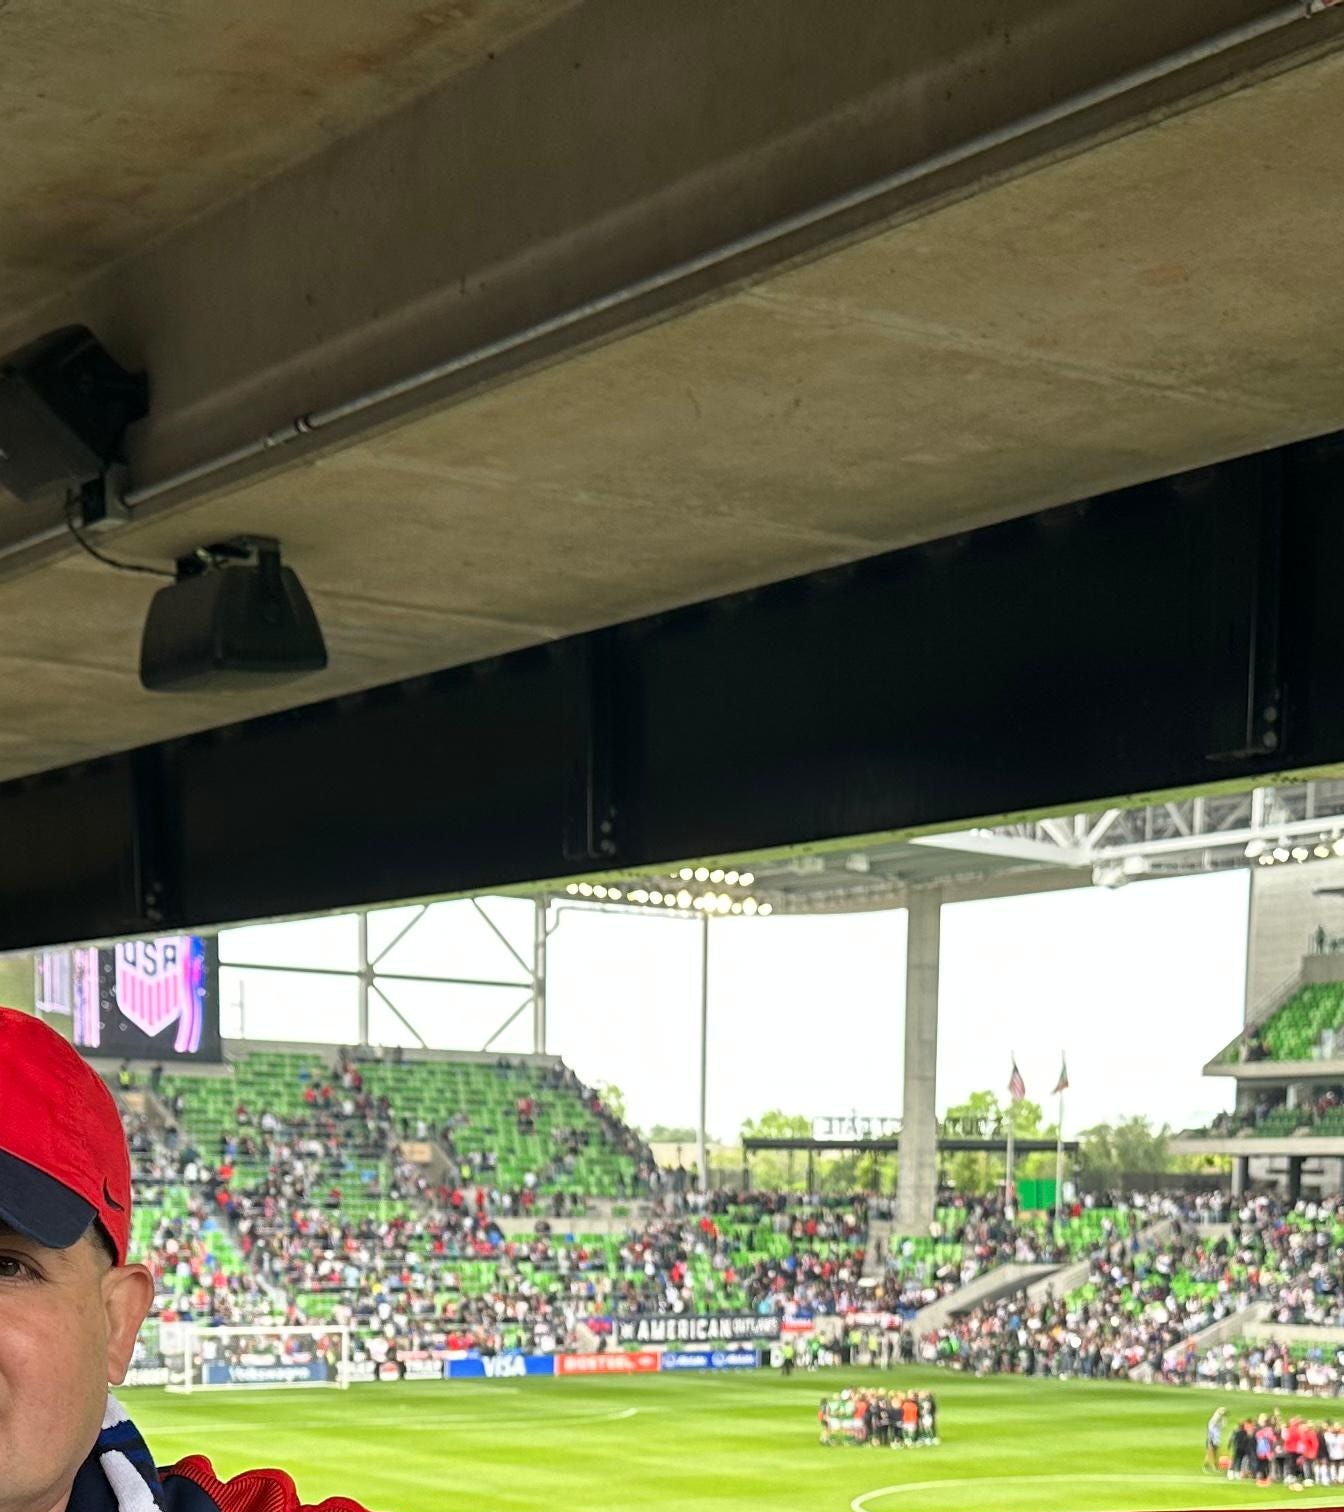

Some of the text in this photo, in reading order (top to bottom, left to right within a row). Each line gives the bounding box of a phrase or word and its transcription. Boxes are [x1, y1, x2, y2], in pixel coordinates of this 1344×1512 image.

[123, 943, 177, 977] USA
[637, 1317, 733, 1343] AMERICAN
[481, 1355, 528, 1378] VISA
